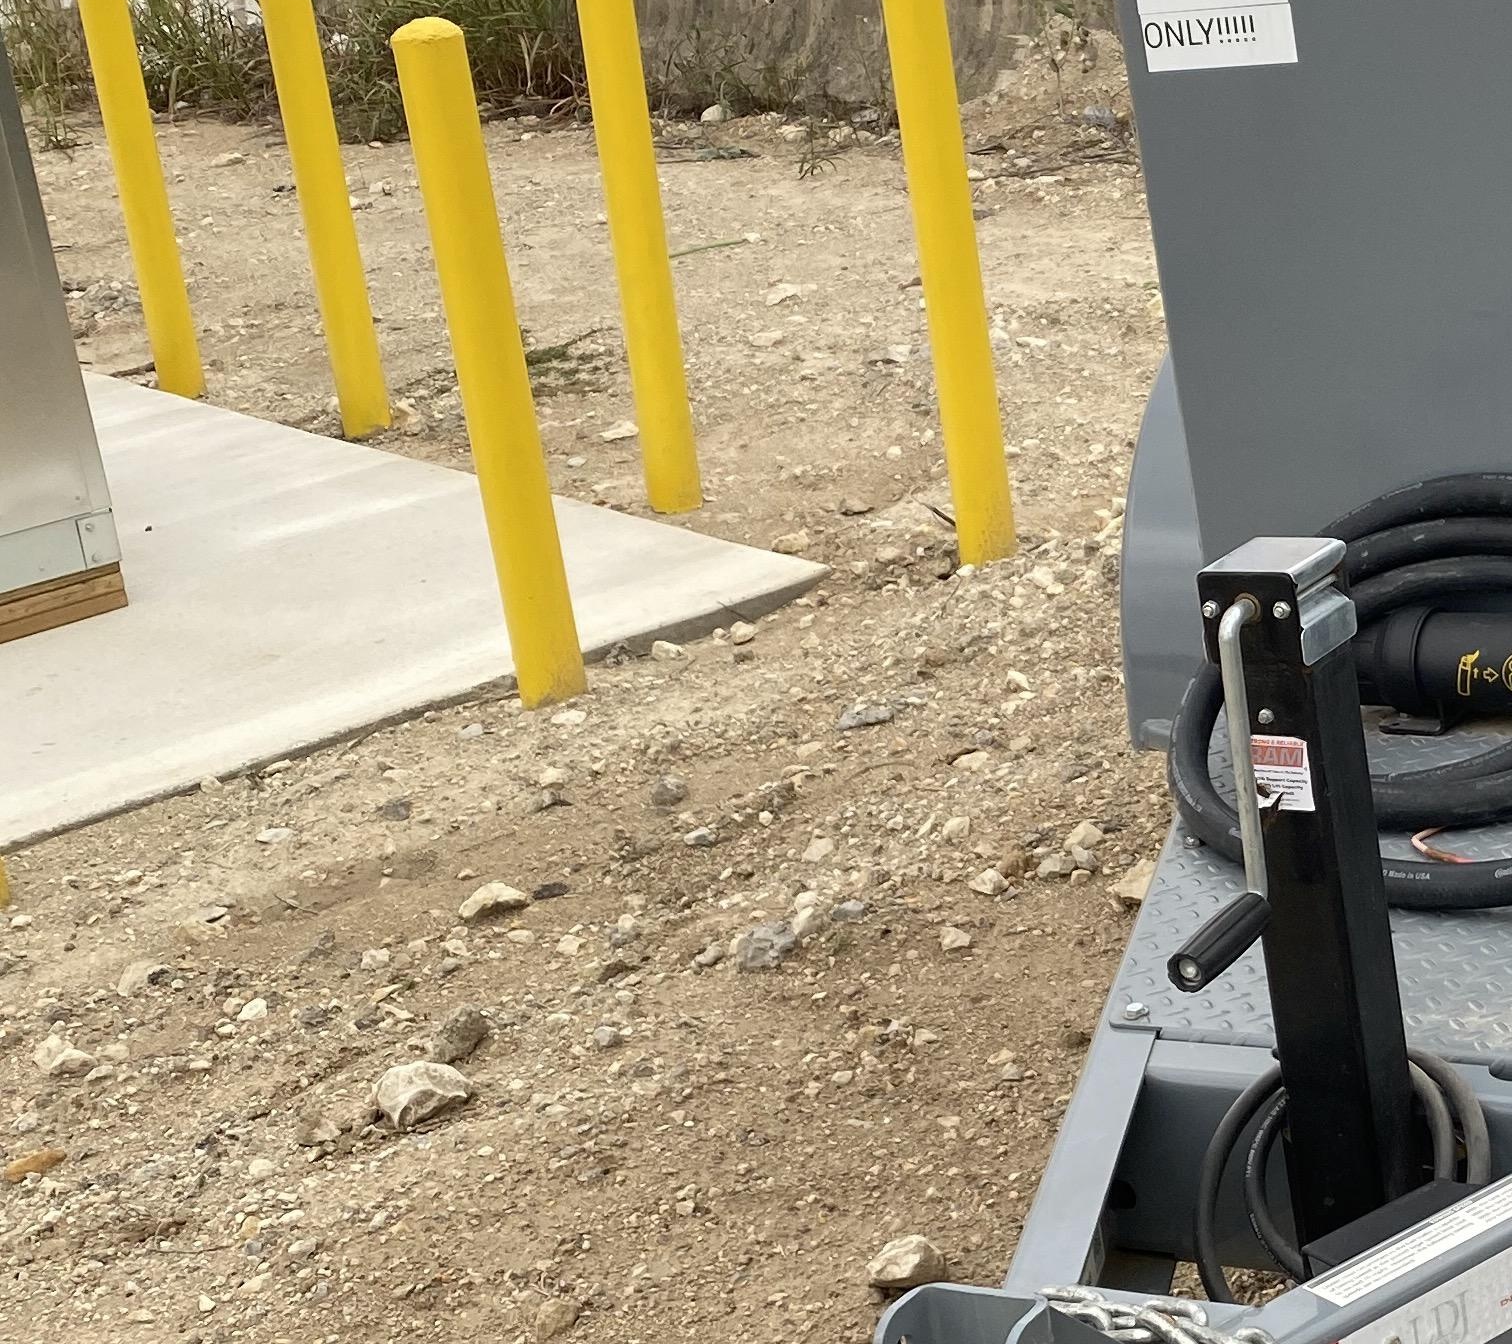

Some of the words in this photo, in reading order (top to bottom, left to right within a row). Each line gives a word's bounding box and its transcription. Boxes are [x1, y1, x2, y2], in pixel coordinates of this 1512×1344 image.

[1144, 15, 1256, 48] ONLY!!!!!
[1388, 869, 1406, 879] Made
[1407, 871, 1414, 879] in
[1415, 872, 1431, 880] USA
